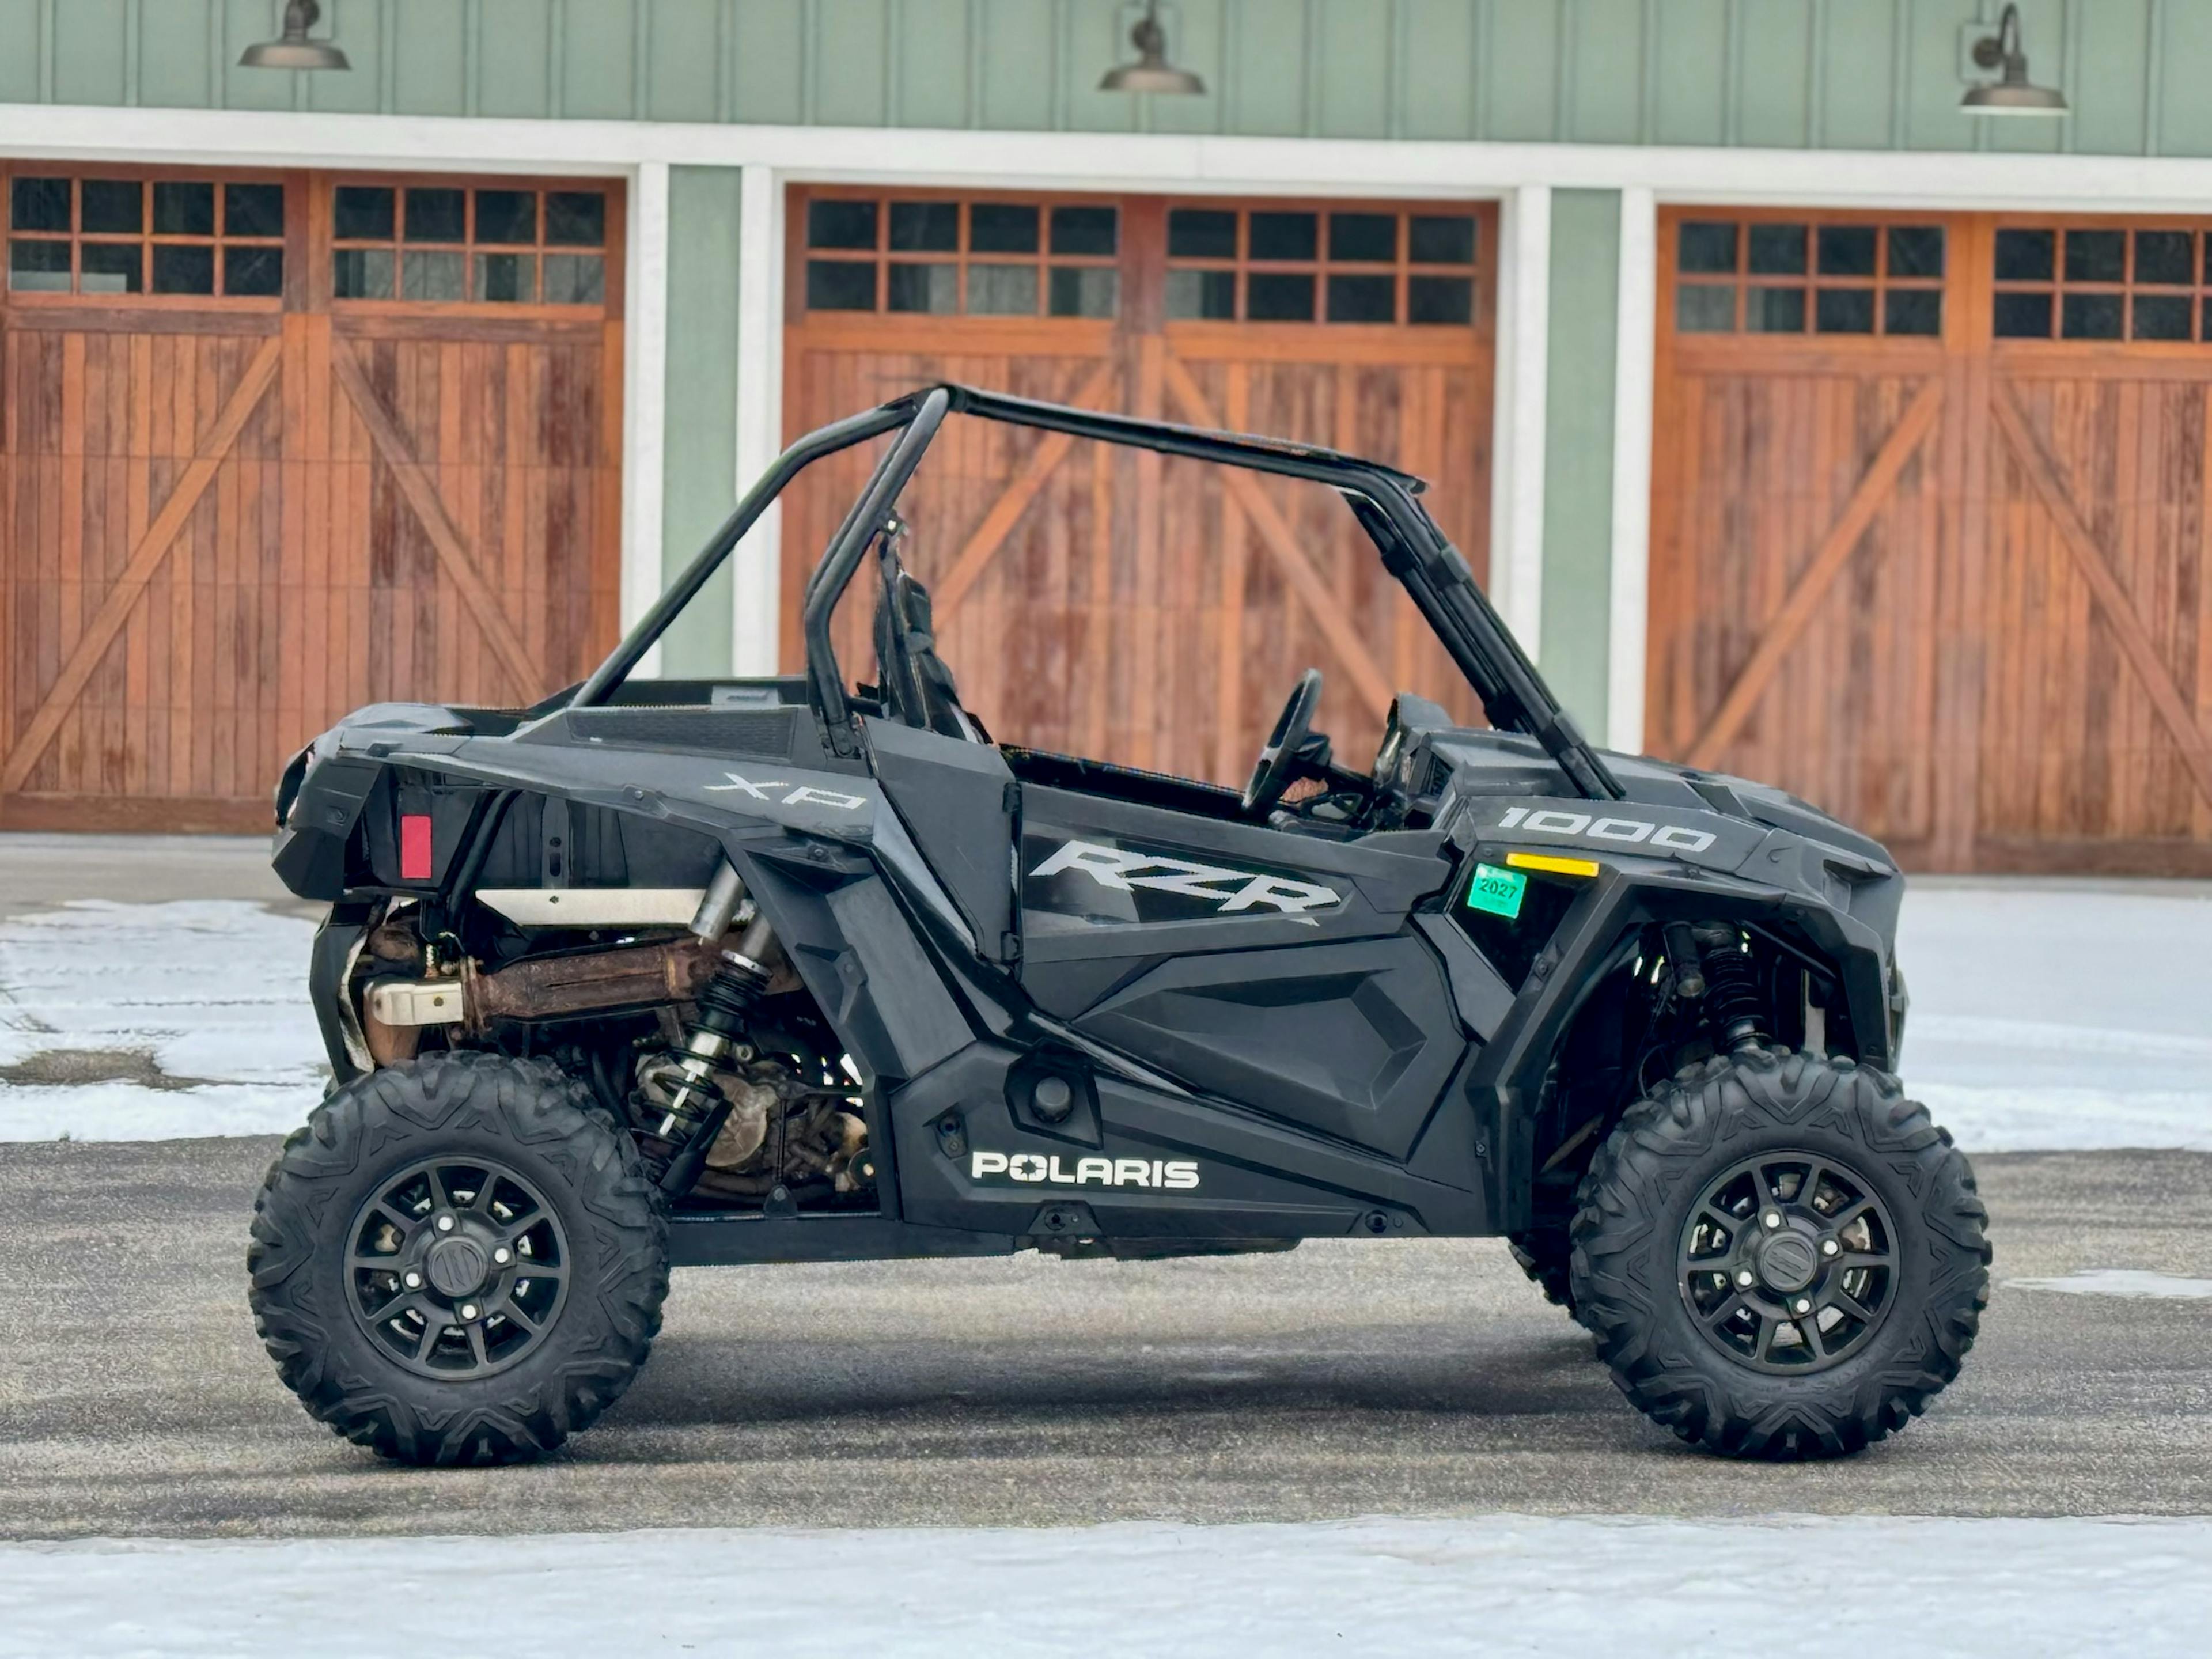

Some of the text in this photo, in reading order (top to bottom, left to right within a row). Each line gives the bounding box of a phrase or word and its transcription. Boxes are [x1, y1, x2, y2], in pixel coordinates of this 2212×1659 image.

[703, 772, 867, 809] XP
[1498, 807, 1717, 853] 1000
[1029, 840, 1341, 926] RZR
[1479, 878, 1518, 899] 2027
[971, 1152, 1200, 1189] POLARIS
